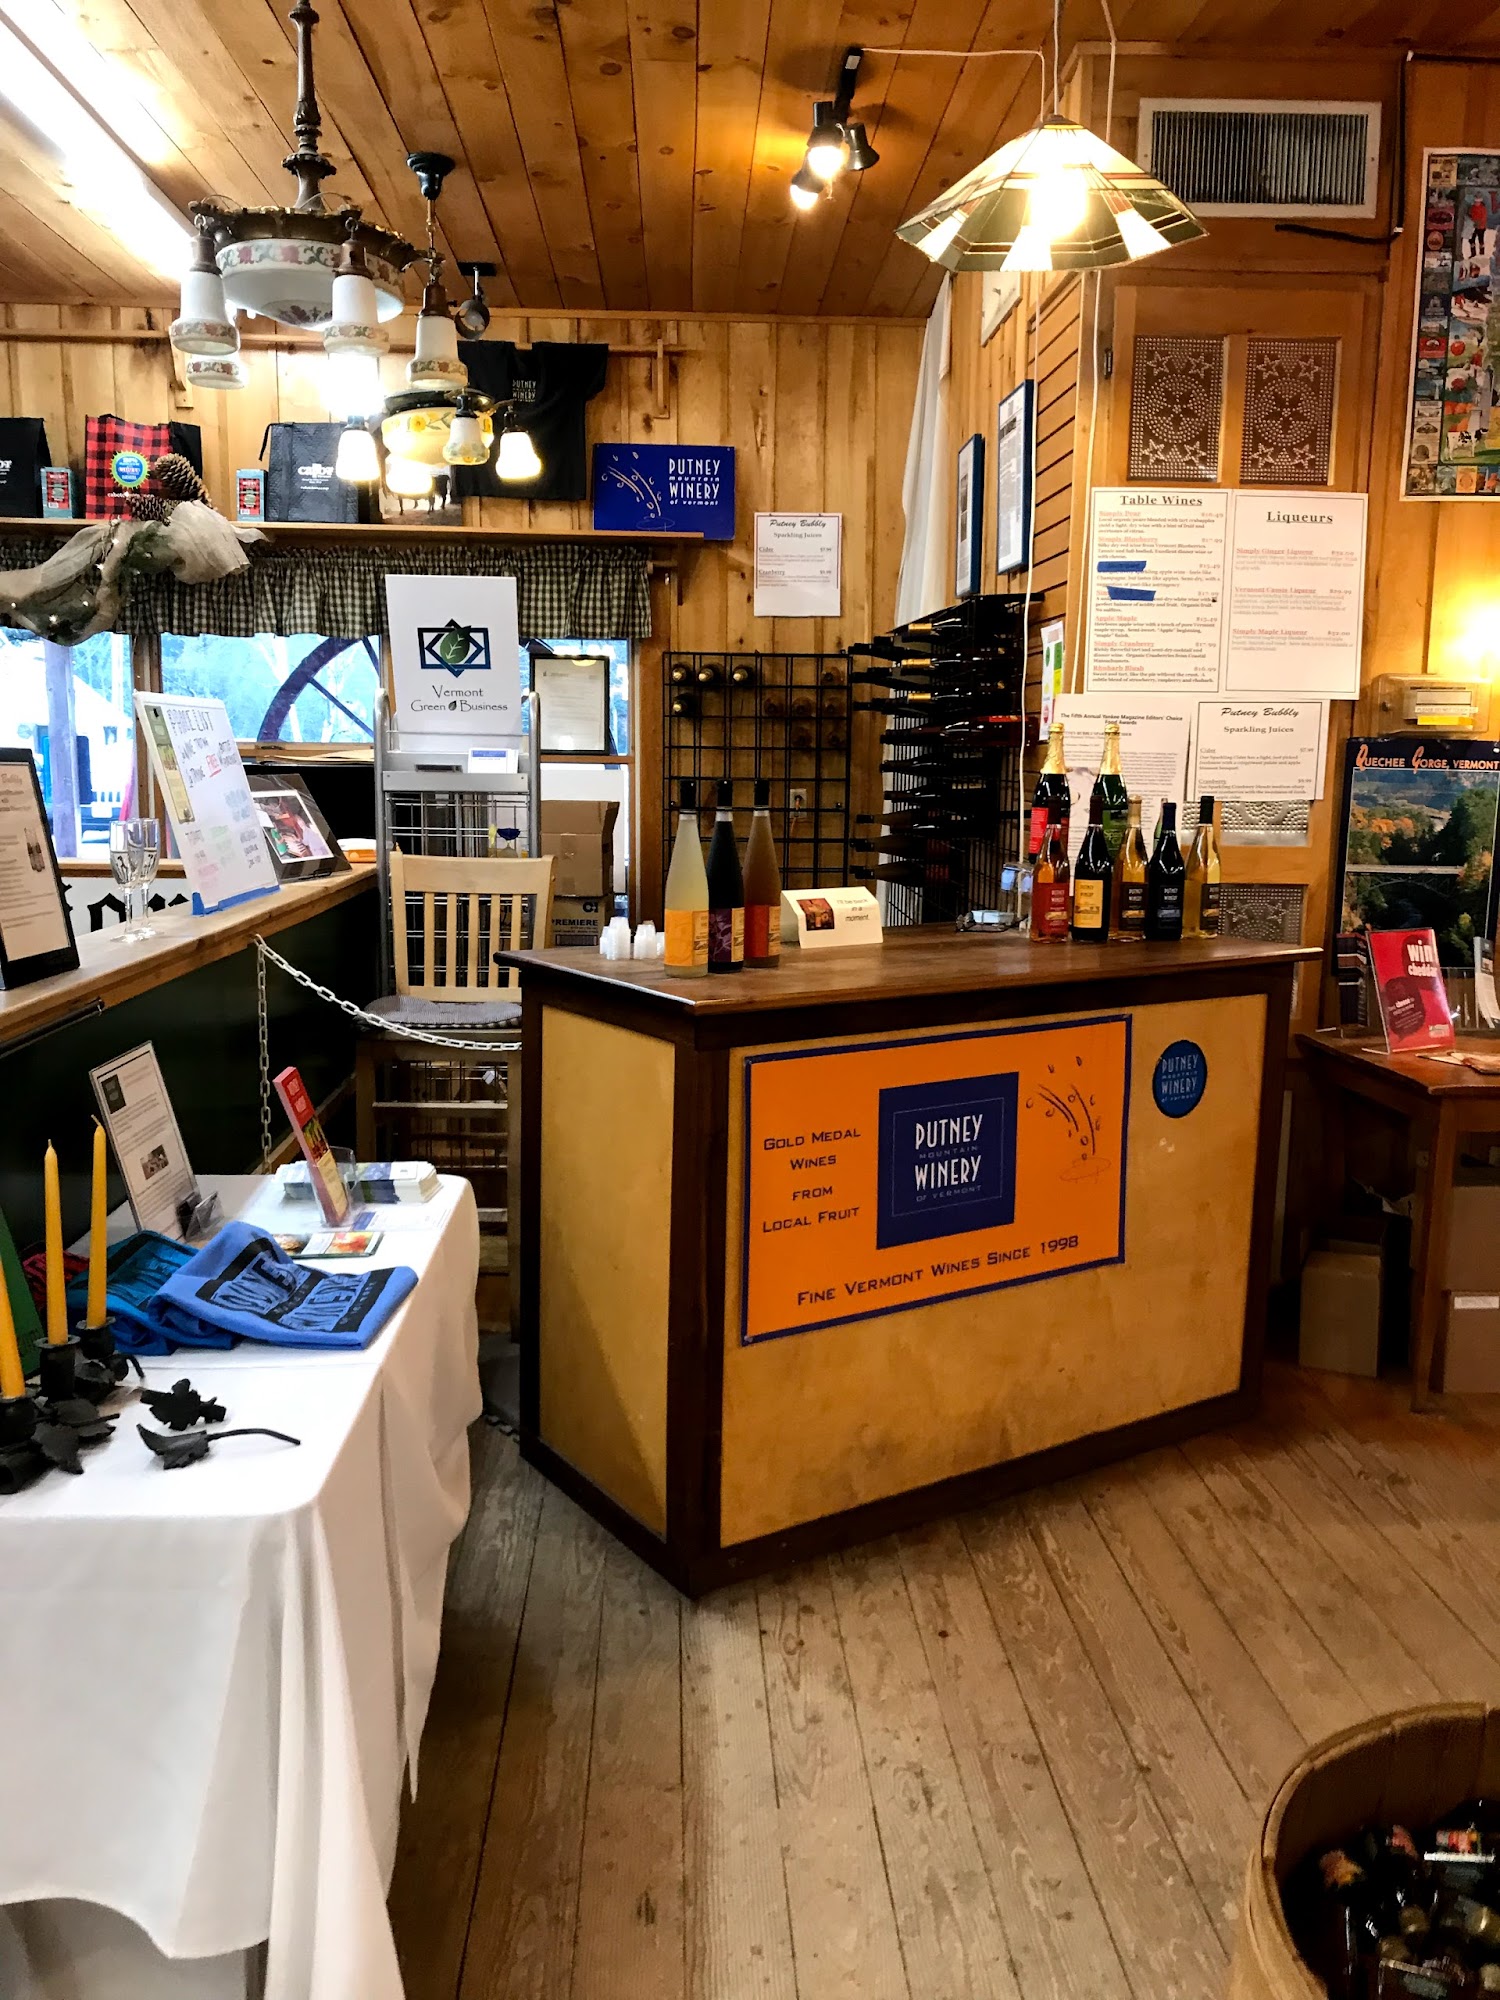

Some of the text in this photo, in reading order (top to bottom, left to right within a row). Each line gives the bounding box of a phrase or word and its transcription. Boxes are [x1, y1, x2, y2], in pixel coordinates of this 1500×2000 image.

[669, 458, 720, 475] PUTNEY
[670, 482, 719, 499] WINERY
[1120, 496, 1203, 505] Table Wines
[770, 519, 826, 528] Putney Bubbly
[1267, 511, 1333, 523] Liqueurs
[432, 685, 483, 698] Vermont
[411, 700, 508, 712] Green Business
[1221, 707, 1299, 717] Putney Bubbly
[1356, 744, 1405, 771] QUECHEE
[1453, 760, 1499, 769] VERMONT
[1162, 1054, 1198, 1073] PUTNEY
[1162, 1077, 1196, 1095] WINERY
[764, 1128, 861, 1150] GOLD MEDAL
[916, 1114, 983, 1150] PUTNEY
[920, 1146, 978, 1159] MOUNTAIN
[790, 1155, 836, 1170] WINES
[915, 1155, 981, 1191] WINERY
[792, 1186, 832, 1201] FROM
[932, 1185, 981, 1198] VERMONT
[763, 1207, 859, 1233] LOCAL FRUIT
[797, 1235, 1079, 1306] FINE VERMONT WINES SINCE 1998
